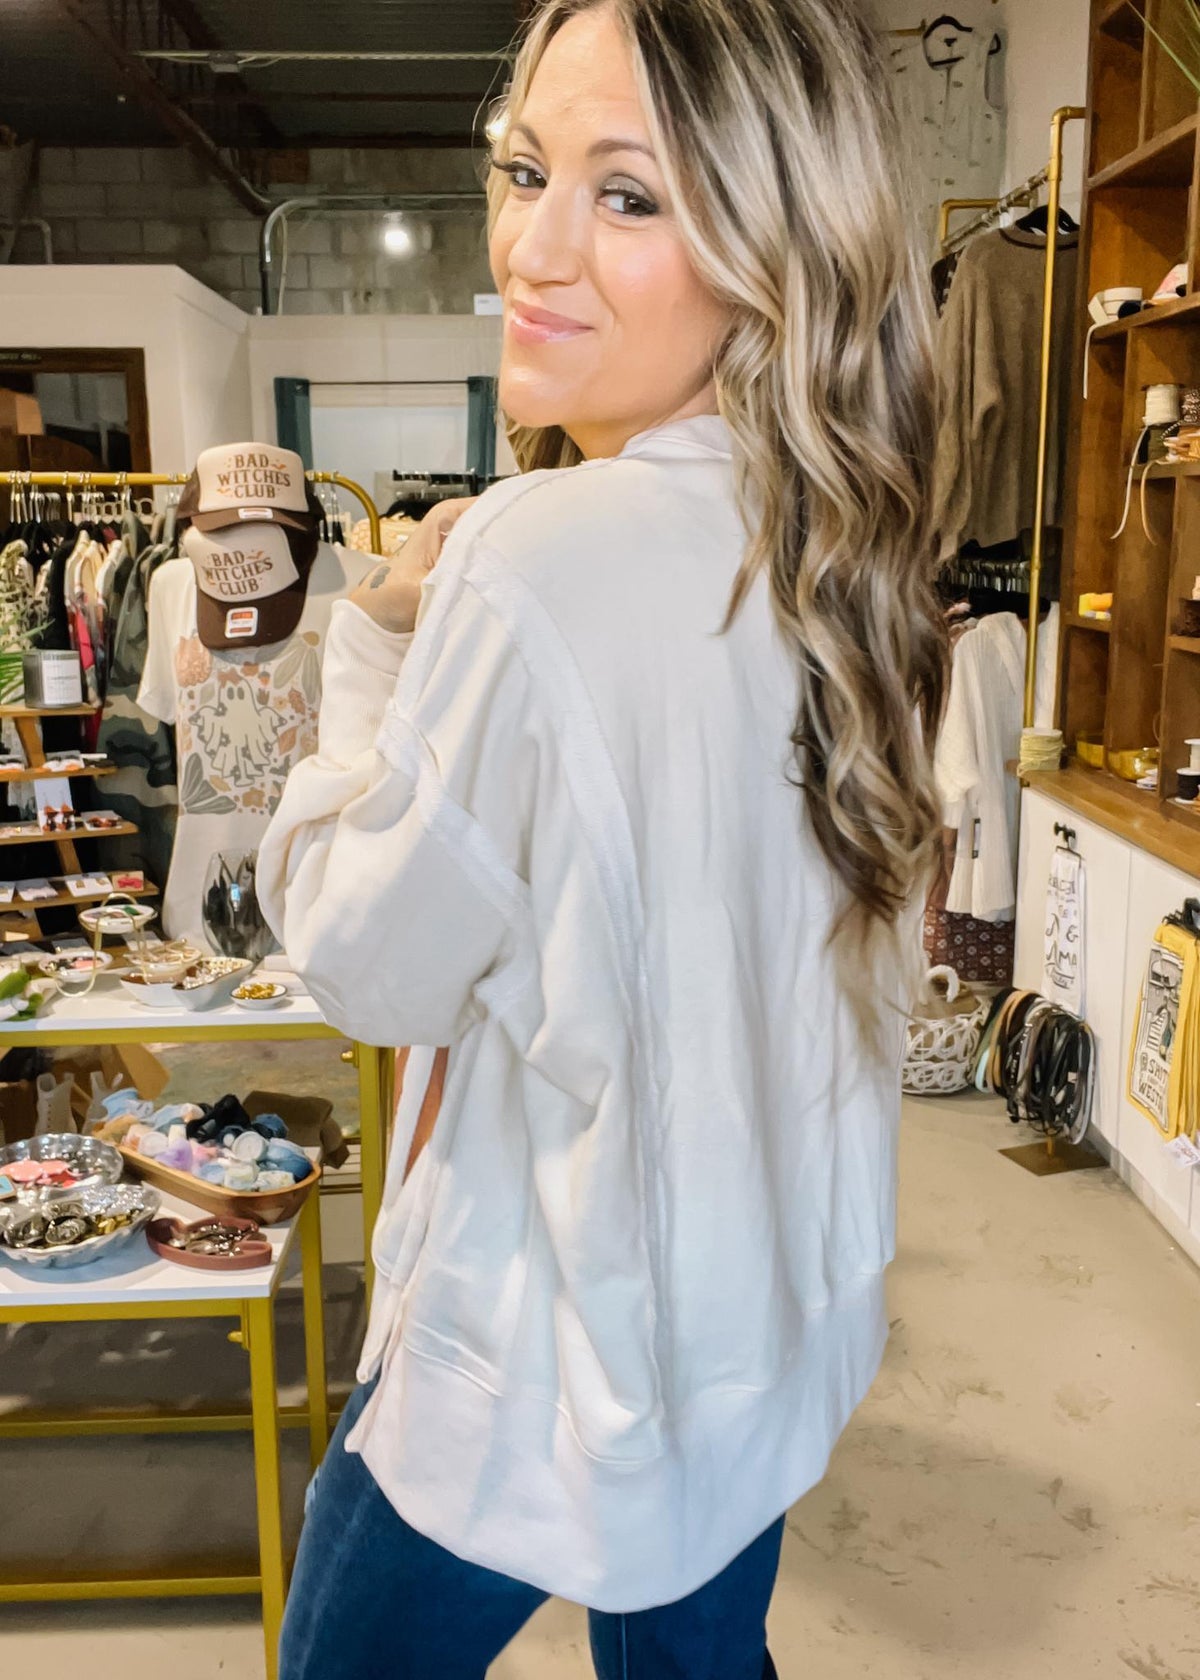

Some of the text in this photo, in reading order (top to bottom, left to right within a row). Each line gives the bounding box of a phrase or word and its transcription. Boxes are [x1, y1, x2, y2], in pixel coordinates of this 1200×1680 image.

[234, 453, 269, 468] BAD
[217, 469, 291, 487] WITCHES
[234, 484, 275, 498] CLUB
[211, 550, 245, 567] BAD
[201, 557, 273, 581] WITCHES
[219, 578, 259, 595] CLUB
